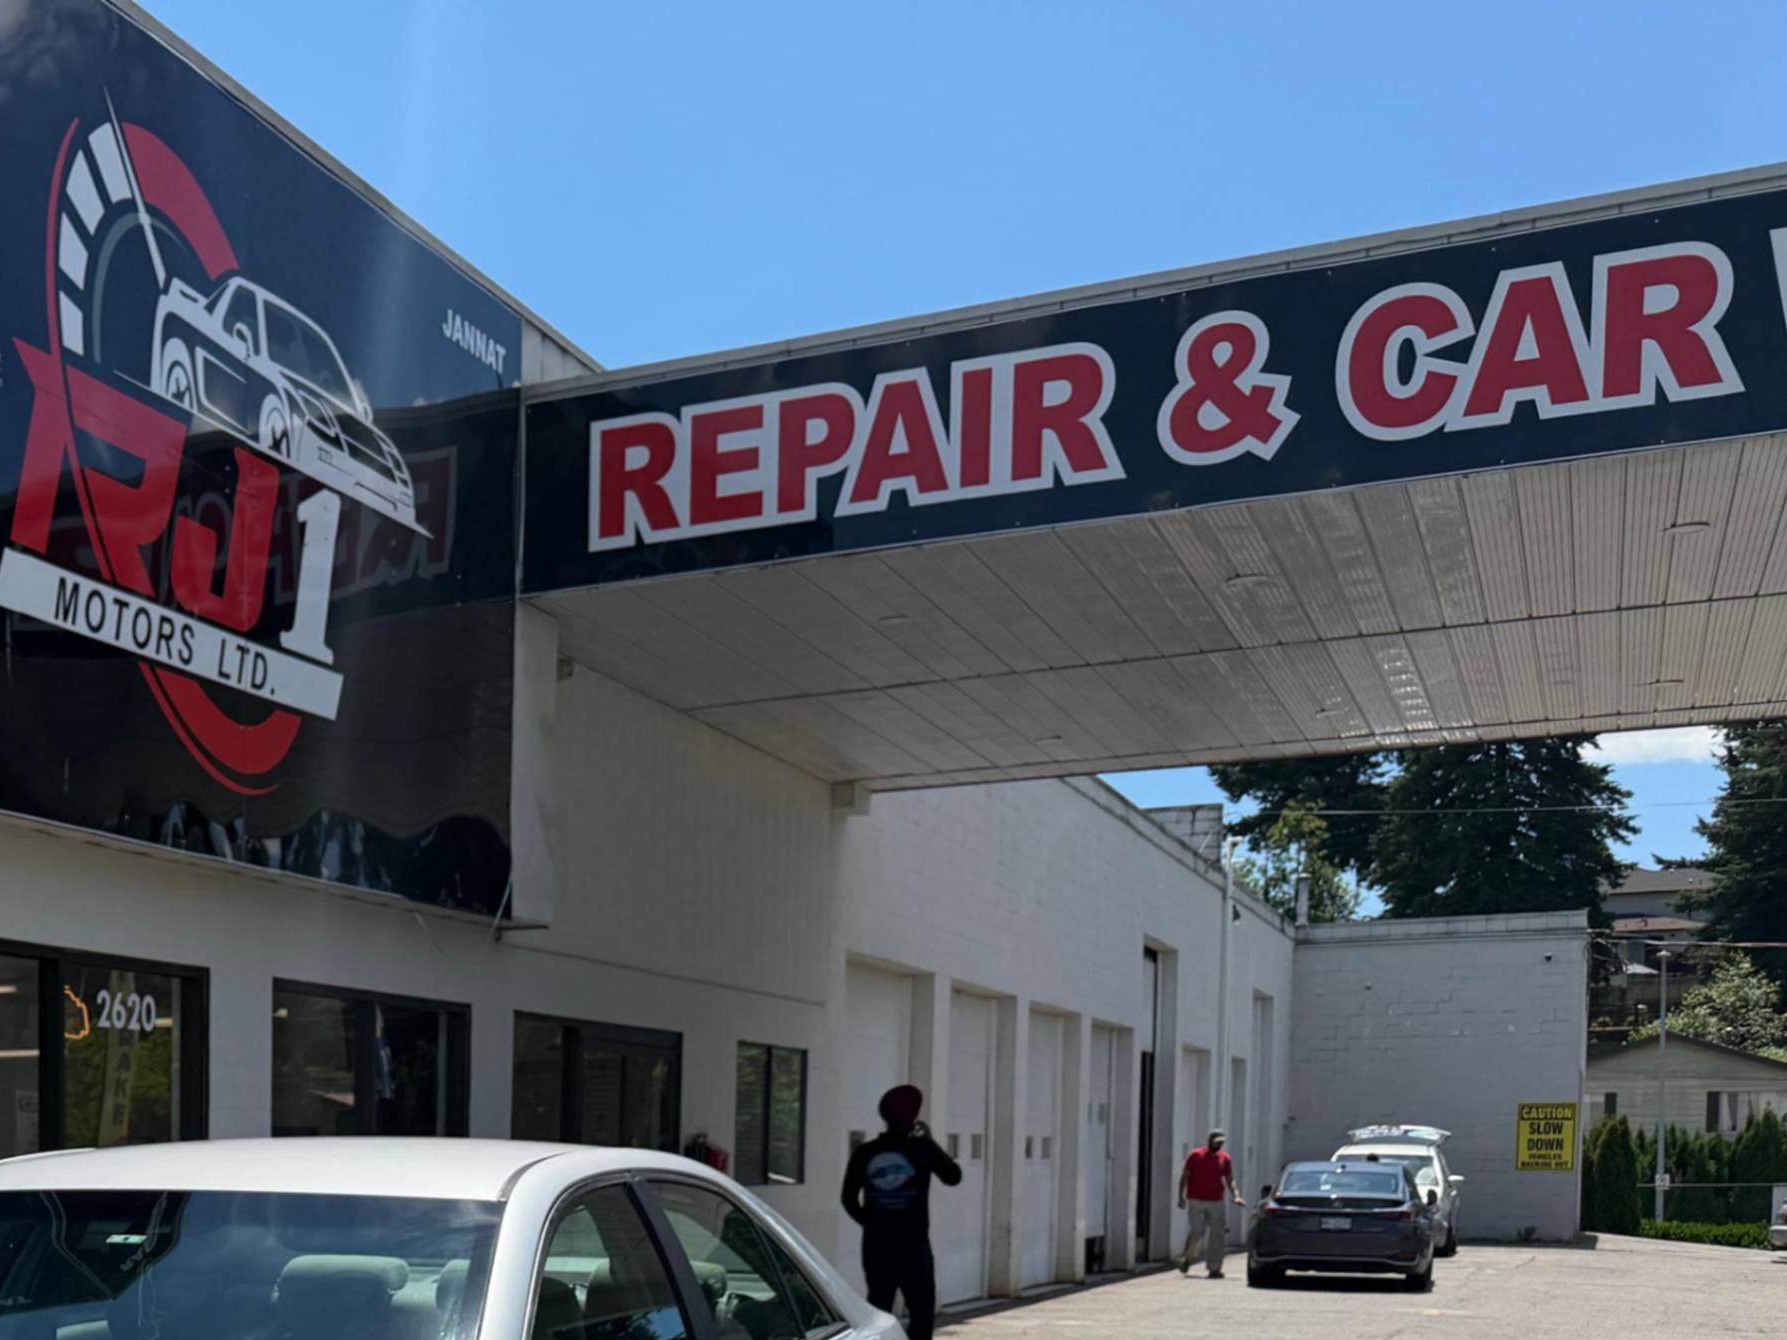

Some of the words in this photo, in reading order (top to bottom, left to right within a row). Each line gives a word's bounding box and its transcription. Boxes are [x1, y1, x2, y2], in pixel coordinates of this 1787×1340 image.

[442, 308, 508, 375] JANNAT
[588, 341, 1127, 554] REPAIR
[1157, 309, 1303, 466] &
[1334, 241, 1746, 442] CAR
[54, 577, 195, 668] MOTORS
[216, 638, 278, 695] LTD.
[96, 989, 157, 1033] 2620
[1522, 1107, 1572, 1119] CAUTION
[1528, 1122, 1563, 1135] SLOW
[1526, 1138, 1564, 1151] DOWN
